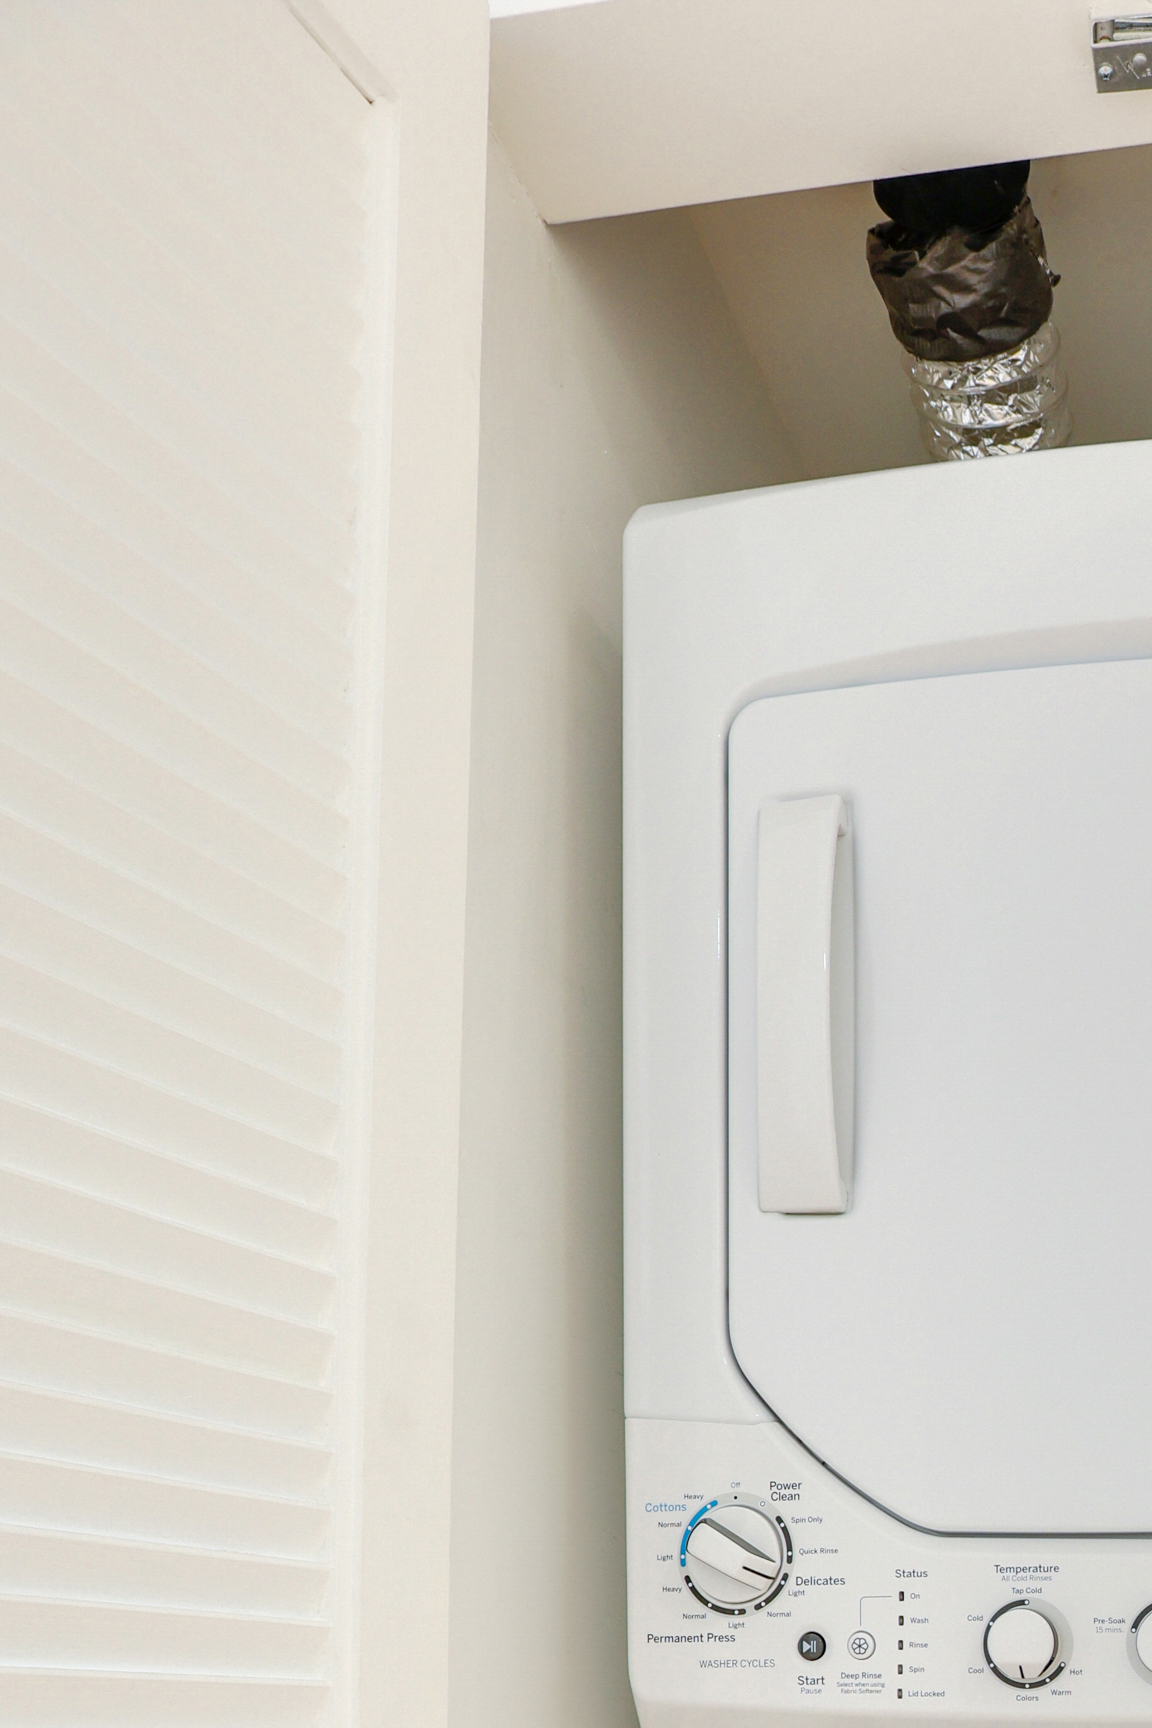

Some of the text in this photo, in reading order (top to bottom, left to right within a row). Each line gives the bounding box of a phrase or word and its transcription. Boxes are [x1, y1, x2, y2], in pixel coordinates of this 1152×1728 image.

[731, 1481, 740, 1489] Off
[770, 1481, 802, 1491] Power
[684, 1493, 703, 1501] Heavy
[771, 1492, 800, 1502] Clean
[645, 1502, 687, 1513] Cottons
[791, 1515, 823, 1524] Spin Only
[799, 1547, 838, 1555] Quick Rinse
[657, 1553, 673, 1562] Light
[994, 1563, 1059, 1574] Temperature
[895, 1569, 928, 1578] Status
[1001, 1574, 1052, 1582] All Cold Rinses
[796, 1576, 845, 1586] Delicates
[663, 1585, 682, 1594] Heavy
[788, 1589, 805, 1597] Light
[1012, 1586, 1042, 1595] Tap Cold
[910, 1616, 928, 1624] Wash
[728, 1621, 745, 1629] Light
[647, 1632, 736, 1644] Permanent Press
[909, 1641, 928, 1649] Rinse
[700, 1658, 775, 1668] WASHER CYCLES
[909, 1665, 924, 1674] Spin
[968, 1667, 984, 1675] Cool
[841, 1671, 882, 1680] Deep Rinse
[797, 1675, 825, 1686] Start
[908, 1690, 945, 1698] Lid Locked
[1016, 1694, 1039, 1702] Colors
